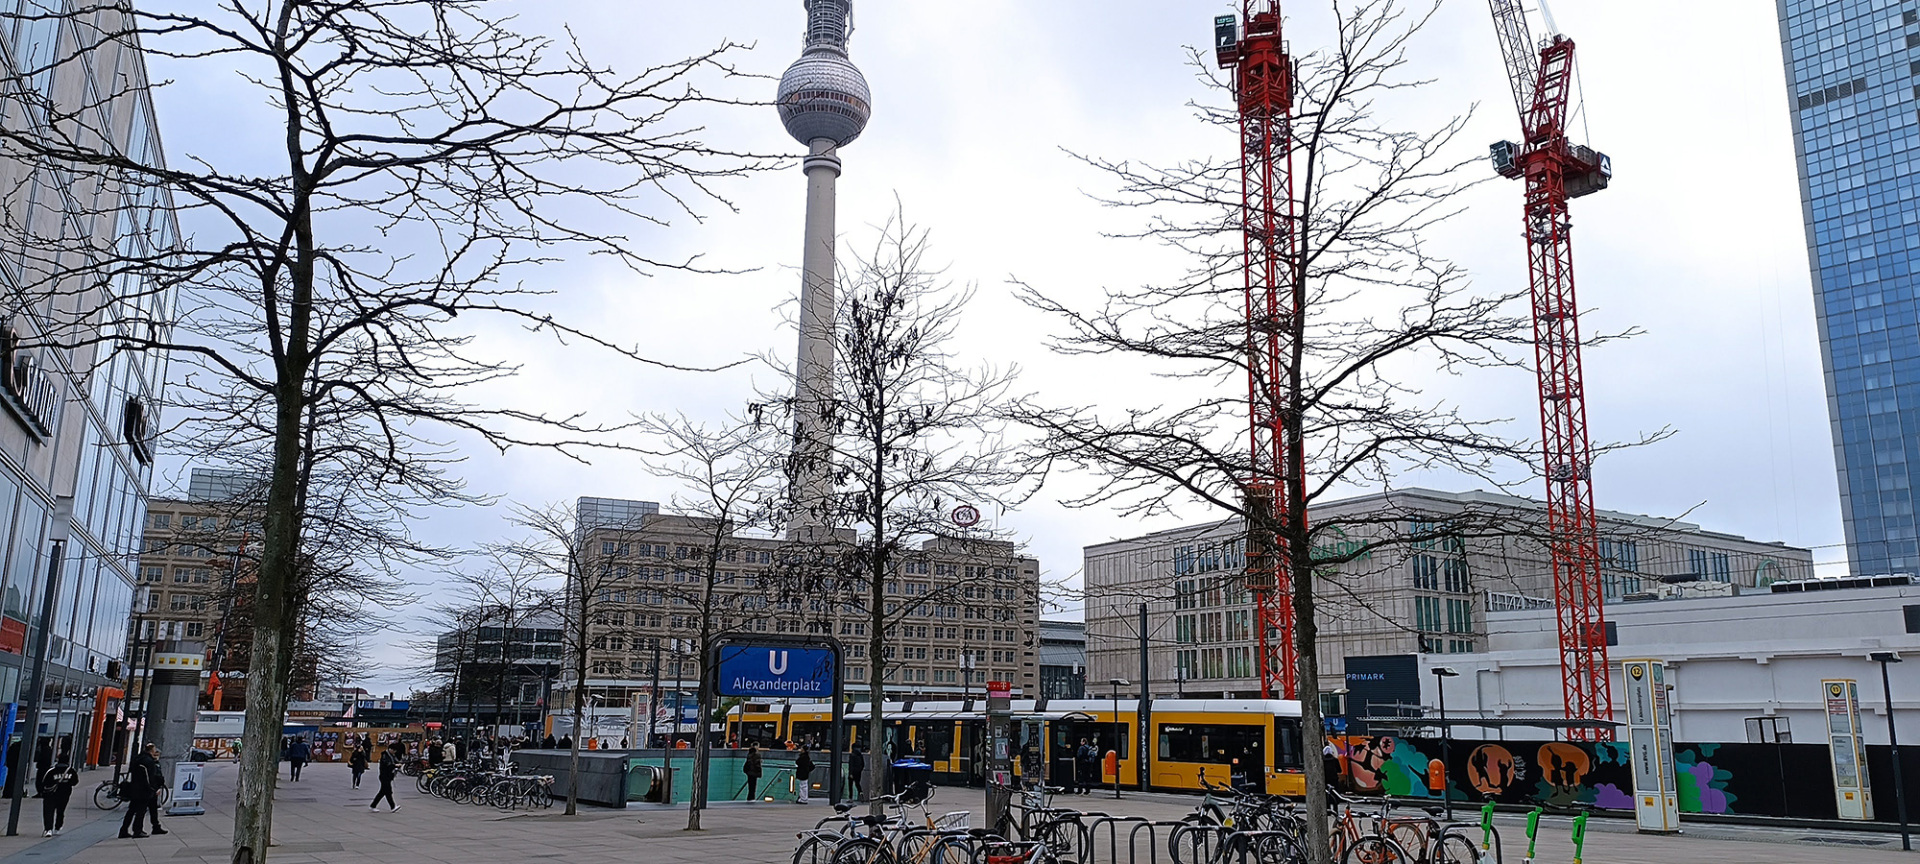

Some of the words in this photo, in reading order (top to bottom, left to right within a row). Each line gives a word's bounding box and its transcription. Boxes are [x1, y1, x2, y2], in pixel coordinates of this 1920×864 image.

[23, 356, 59, 438] SATURN
[768, 649, 789, 676] U
[1633, 667, 1641, 675] 12
[732, 676, 821, 694] Alexanderplatz
[1345, 673, 1385, 681] PRIMARK
